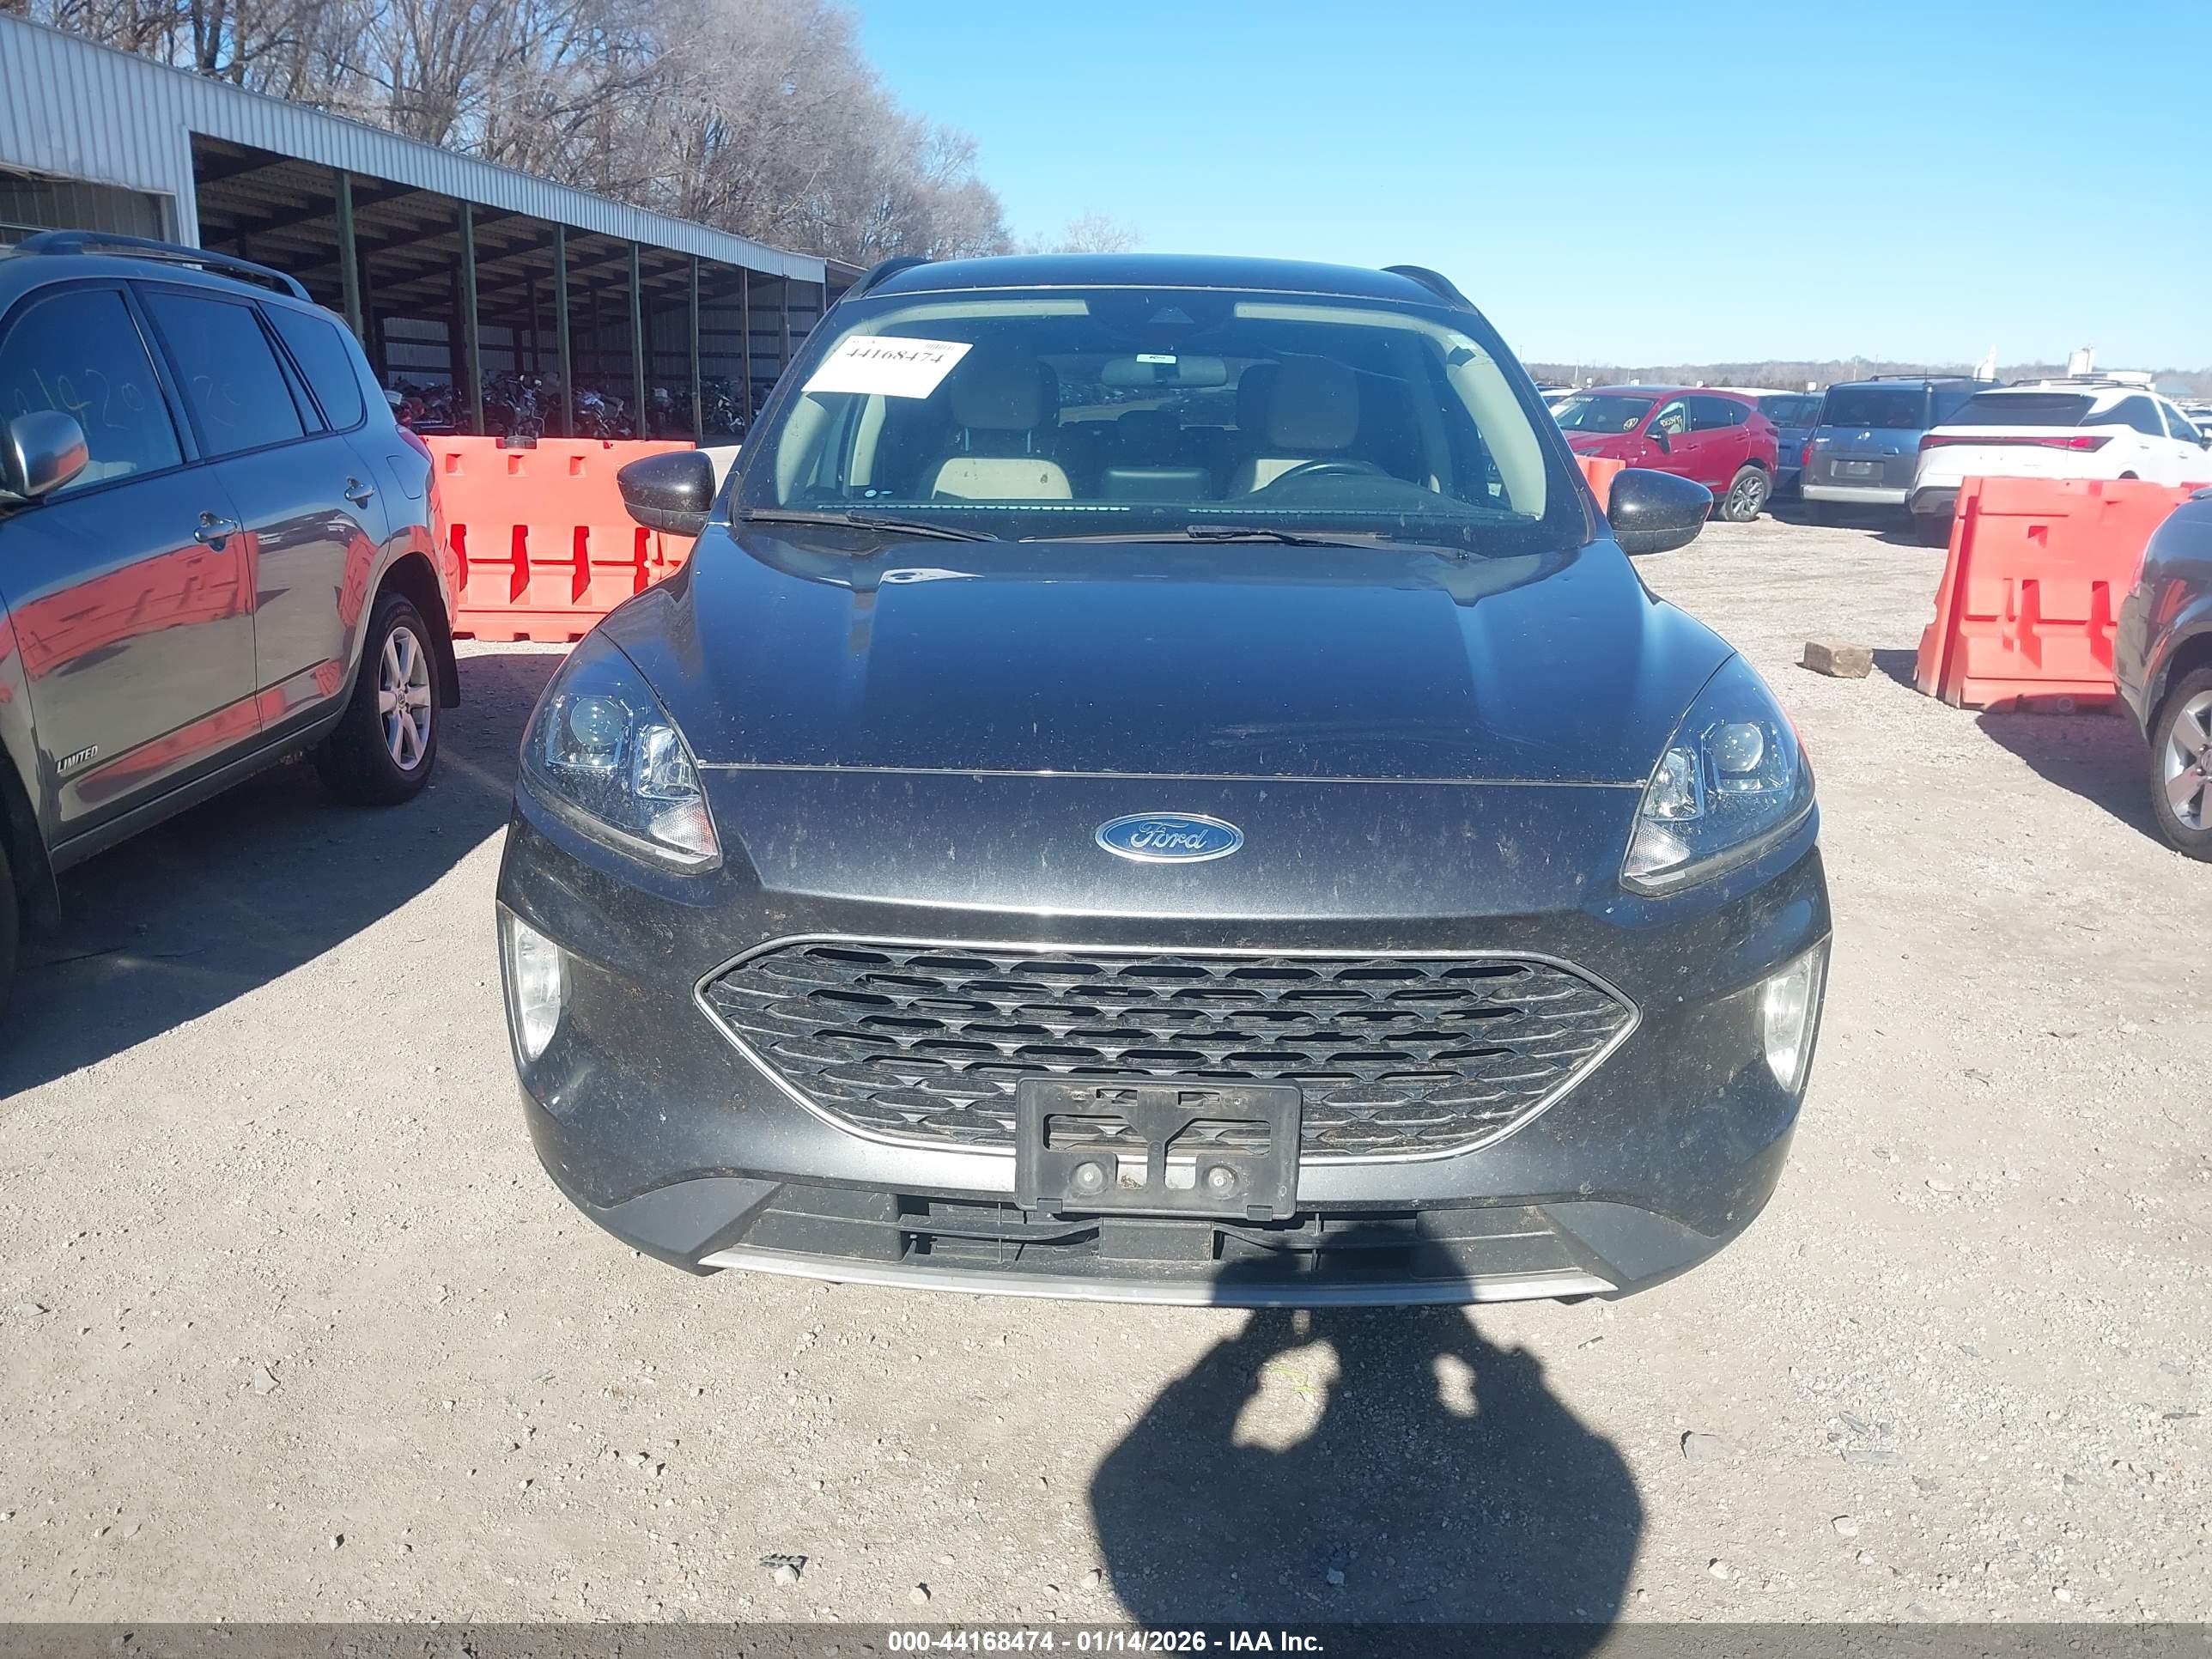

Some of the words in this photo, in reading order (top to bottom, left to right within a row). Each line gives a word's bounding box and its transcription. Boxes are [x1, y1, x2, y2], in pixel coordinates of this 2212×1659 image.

[846, 348, 945, 364] 44168474
[57, 744, 98, 774] LIMITED
[1130, 821, 1209, 849] Ford
